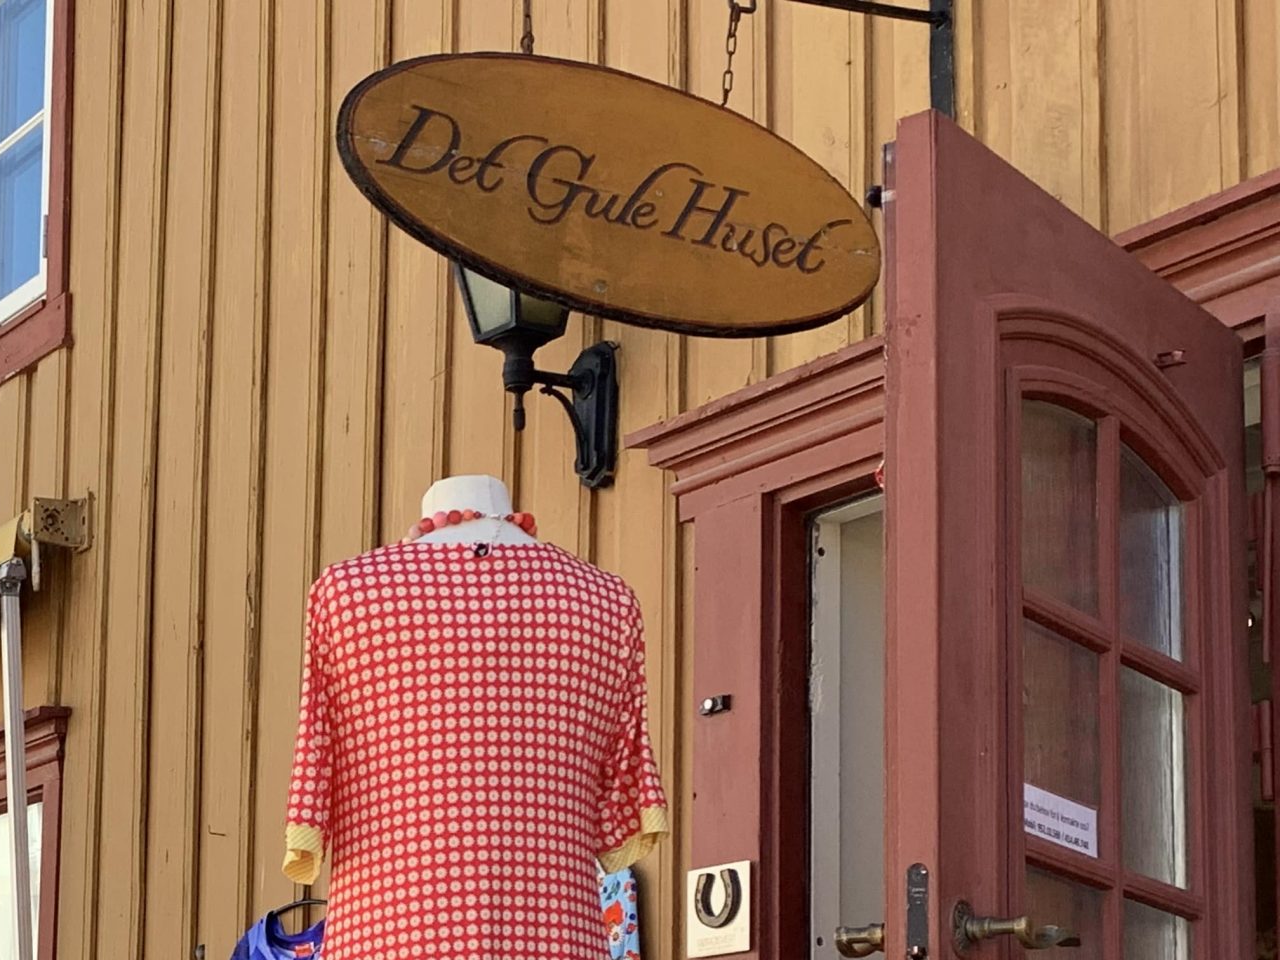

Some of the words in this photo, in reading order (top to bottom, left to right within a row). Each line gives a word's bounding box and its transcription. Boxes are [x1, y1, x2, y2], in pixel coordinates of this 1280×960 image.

[376, 105, 548, 193] Det
[526, 145, 704, 226] Gule
[660, 178, 854, 274] Huset
